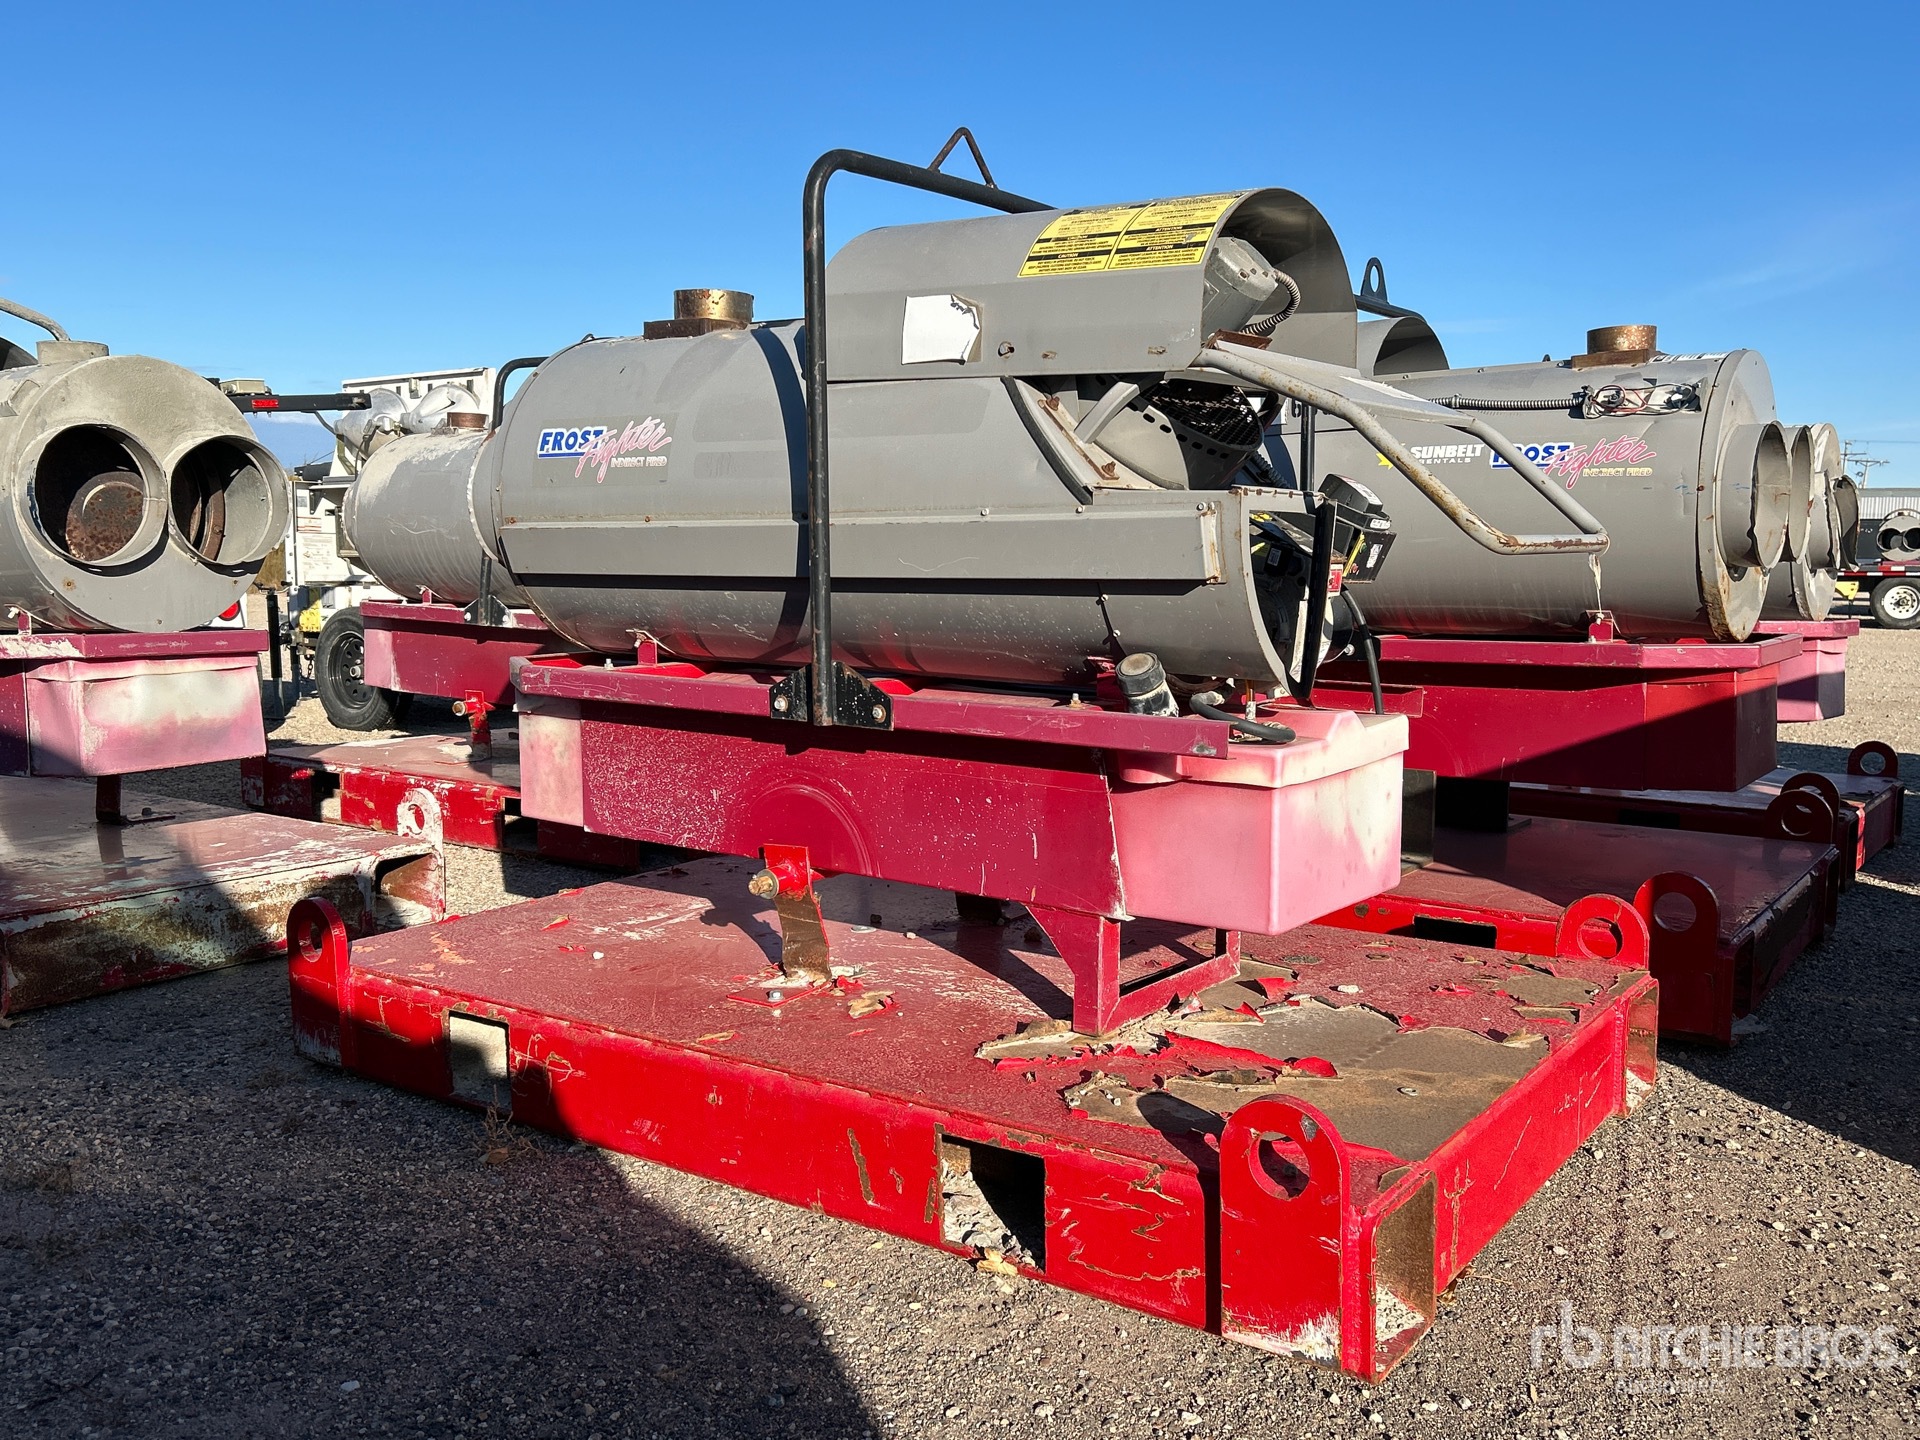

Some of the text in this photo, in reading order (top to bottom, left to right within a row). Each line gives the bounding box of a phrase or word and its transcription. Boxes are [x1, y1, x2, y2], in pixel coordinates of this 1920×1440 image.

[538, 416, 672, 483] FROST Fighter
[1410, 444, 1485, 459] SUNBELT
[611, 456, 667, 468] INDIRECT FIRED
[1543, 435, 1657, 489] Fighter
[1583, 467, 1653, 477] INDIRECT FIRED
